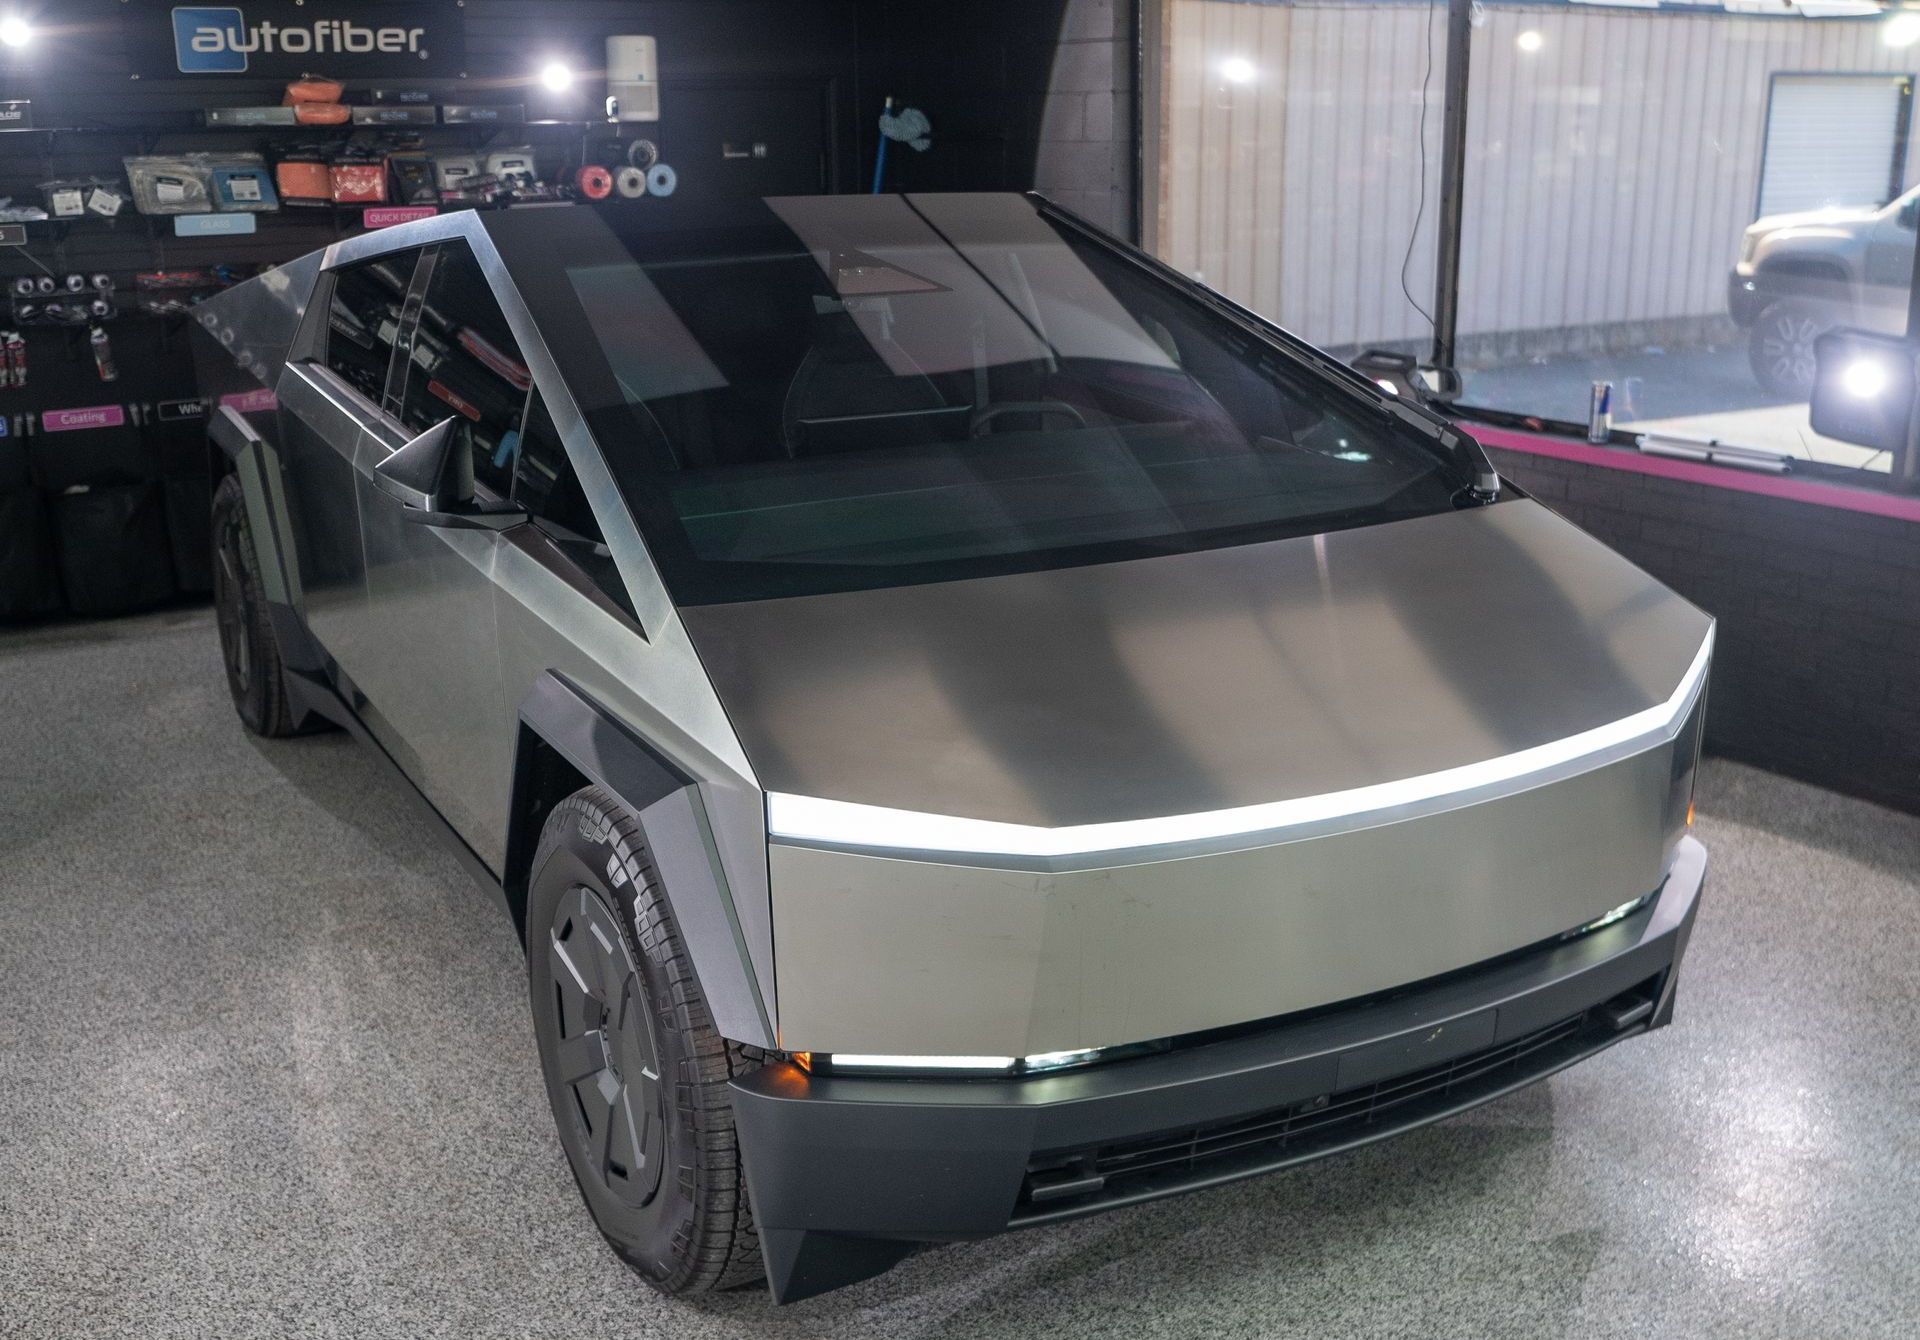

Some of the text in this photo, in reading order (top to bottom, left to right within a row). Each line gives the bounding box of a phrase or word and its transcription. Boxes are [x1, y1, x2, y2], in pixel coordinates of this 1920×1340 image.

[191, 20, 425, 53] autofiber
[371, 213, 399, 224] QUICK
[61, 410, 106, 425] Coating
